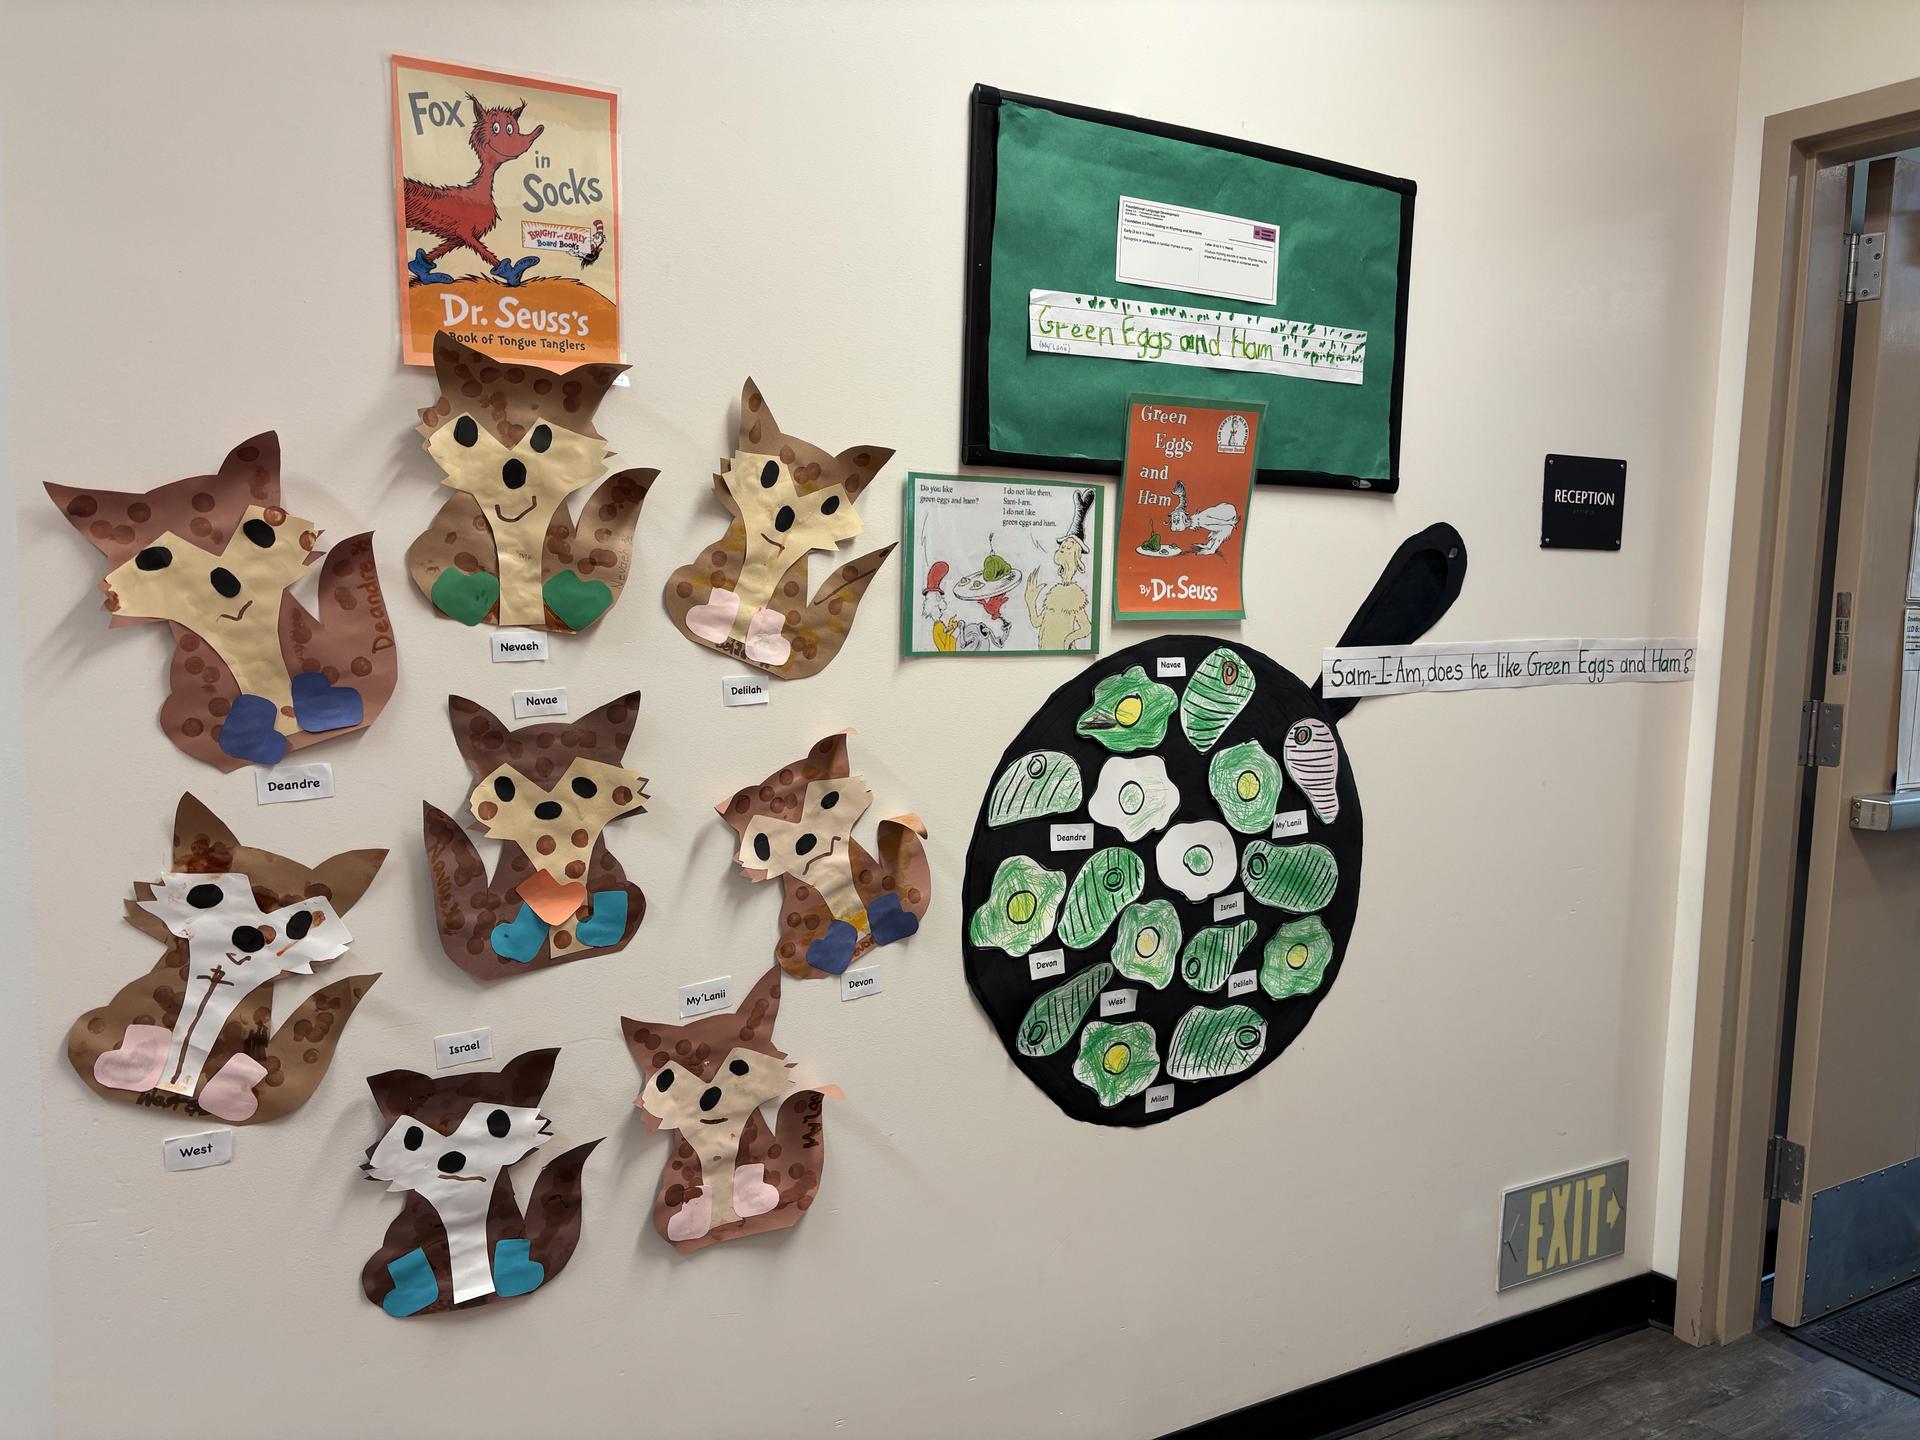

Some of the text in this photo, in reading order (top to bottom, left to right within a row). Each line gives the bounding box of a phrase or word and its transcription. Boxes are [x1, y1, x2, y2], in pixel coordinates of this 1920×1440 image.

[408, 91, 465, 135] Fox
[535, 151, 550, 169] in
[522, 168, 603, 213] Socks
[528, 229, 557, 240] BRIGHT
[564, 232, 587, 244] EARLY
[536, 240, 580, 250] Board Books
[440, 293, 589, 336] Dr. Seuss's
[1038, 303, 1274, 361] Green Eggs and Ham
[449, 332, 586, 353] Book of Tongue Tanglers
[1141, 404, 1188, 424] Green
[1154, 433, 1194, 458] Eggs
[1140, 465, 1168, 480] and
[942, 485, 953, 493] like
[1026, 488, 1036, 496] like
[920, 496, 935, 504] green
[937, 497, 950, 505] eggs
[1138, 490, 1172, 506] Ham
[1554, 488, 1615, 506] RECEPTION
[1139, 575, 1218, 602] By Dr. Seuss
[500, 640, 540, 653] Nevaeh
[1427, 655, 1464, 682] does
[1471, 653, 1489, 679] he
[1497, 651, 1522, 678] like
[1527, 651, 1571, 677] Green
[1578, 649, 1614, 683] Eggs
[1620, 647, 1646, 674] and
[1651, 648, 1694, 674] Ham?
[730, 684, 762, 696] Delilah
[526, 696, 558, 706] Navae
[267, 778, 321, 792] Deandre
[1056, 834, 1086, 842] Deandre
[1220, 900, 1238, 911] Israel
[1036, 960, 1058, 970] Devon
[848, 976, 874, 989] Devon
[1233, 978, 1253, 988] Delilah
[686, 989, 726, 1006] My'Lanii
[1108, 996, 1126, 1006] West
[449, 1040, 480, 1056] Israel
[179, 1143, 214, 1159] West
[1527, 1173, 1606, 1276] EXIT
